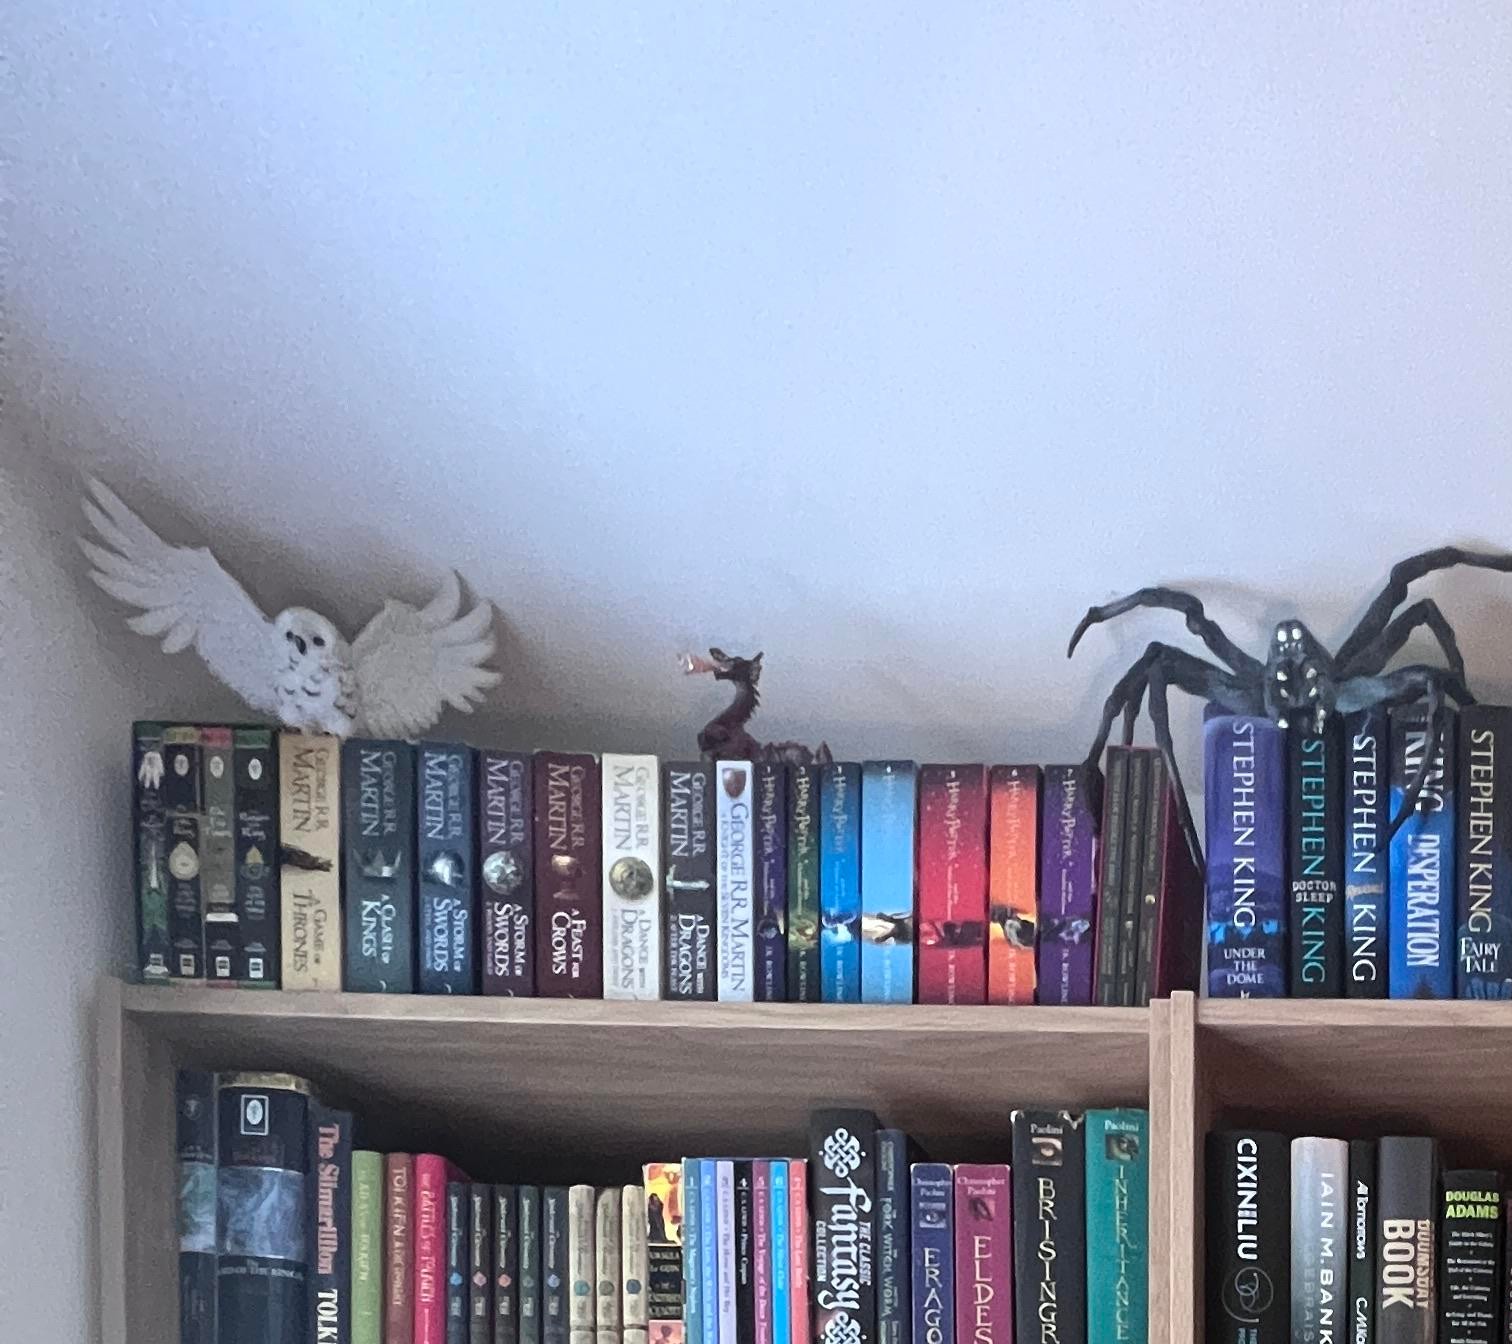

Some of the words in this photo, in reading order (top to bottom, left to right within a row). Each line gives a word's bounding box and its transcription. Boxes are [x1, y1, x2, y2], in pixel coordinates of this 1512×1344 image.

[361, 750, 380, 837] MARTIN
[549, 763, 569, 849] MARTIN
[1232, 722, 1254, 847] STEPHEN
[1302, 740, 1325, 876] STEPHEN
[1470, 730, 1494, 855] STEPHEN
[1233, 857, 1255, 929] KING
[1292, 881, 1336, 891] DOCTOR
[1296, 892, 1333, 902] SLEEP
[1407, 834, 1440, 968] DESPERATION
[1469, 863, 1492, 933] KING
[361, 899, 380, 958] KINGS
[551, 911, 567, 975] CROWS
[1224, 948, 1265, 960] UNDER
[1302, 907, 1325, 983] KING
[1460, 938, 1500, 959] FAIRY
[1226, 972, 1264, 985] DOME
[1233, 960, 1257, 972] THE
[1464, 957, 1496, 973] TALE
[318, 1123, 340, 1159] The
[1236, 1138, 1257, 1209] CIXIN
[1320, 1173, 1334, 1229] IAIN
[1446, 1192, 1499, 1204] DOUGLAS
[318, 1162, 340, 1275] Silmarillion
[859, 1222, 872, 1240] THE
[1236, 1217, 1257, 1261] LIU
[1446, 1205, 1498, 1219] ADAMS
[816, 1221, 826, 1281] COLLECTION
[859, 1244, 872, 1284] CLASSIC
[1038, 1177, 1059, 1344] BRISINGR
[1115, 1165, 1138, 1340] INHERITANCE
[1320, 1238, 1333, 1263] M.
[1382, 1219, 1414, 1309] BOOK
